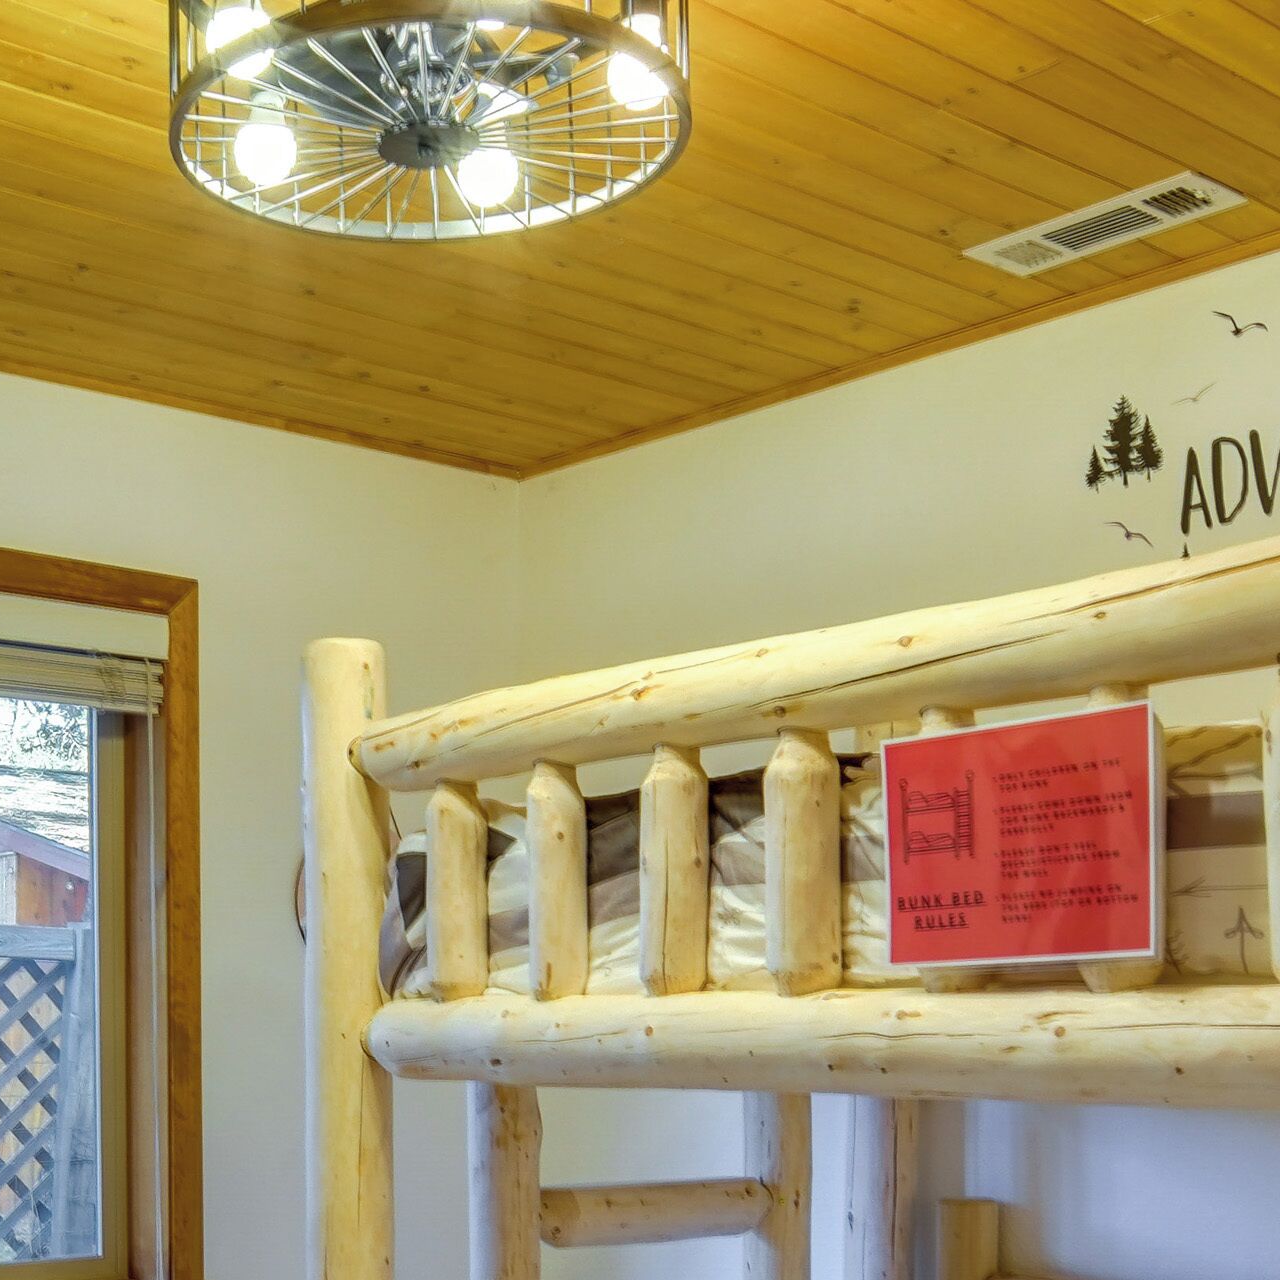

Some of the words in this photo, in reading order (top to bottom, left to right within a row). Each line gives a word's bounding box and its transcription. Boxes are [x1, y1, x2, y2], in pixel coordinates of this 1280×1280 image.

[897, 893, 944, 911] BUNK
[951, 889, 984, 907] BED
[913, 911, 967, 930] RULES
